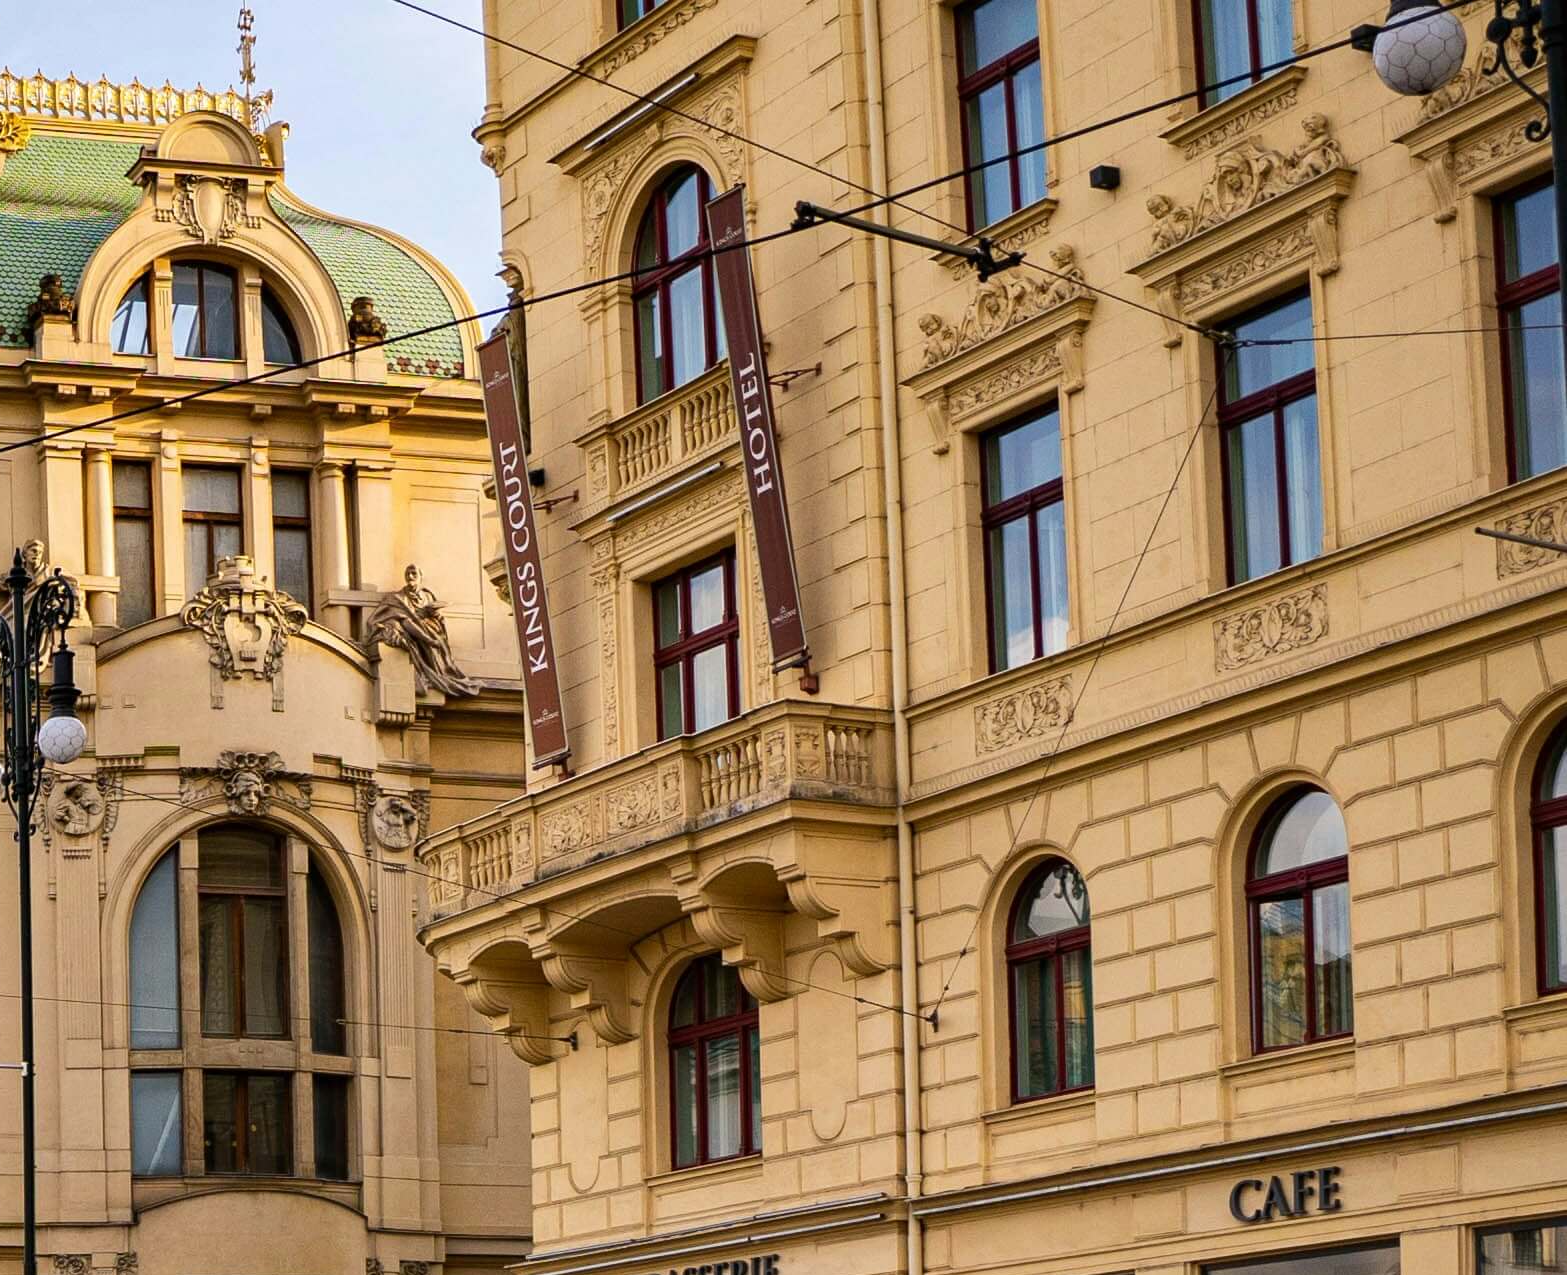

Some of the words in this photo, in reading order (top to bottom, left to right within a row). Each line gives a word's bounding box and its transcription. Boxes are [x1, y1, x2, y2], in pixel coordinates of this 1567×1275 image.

[739, 352, 773, 497] HOTEL
[499, 442, 531, 553] COURT
[517, 561, 549, 673] KINGS
[1229, 1165, 1342, 1223] CAFE
